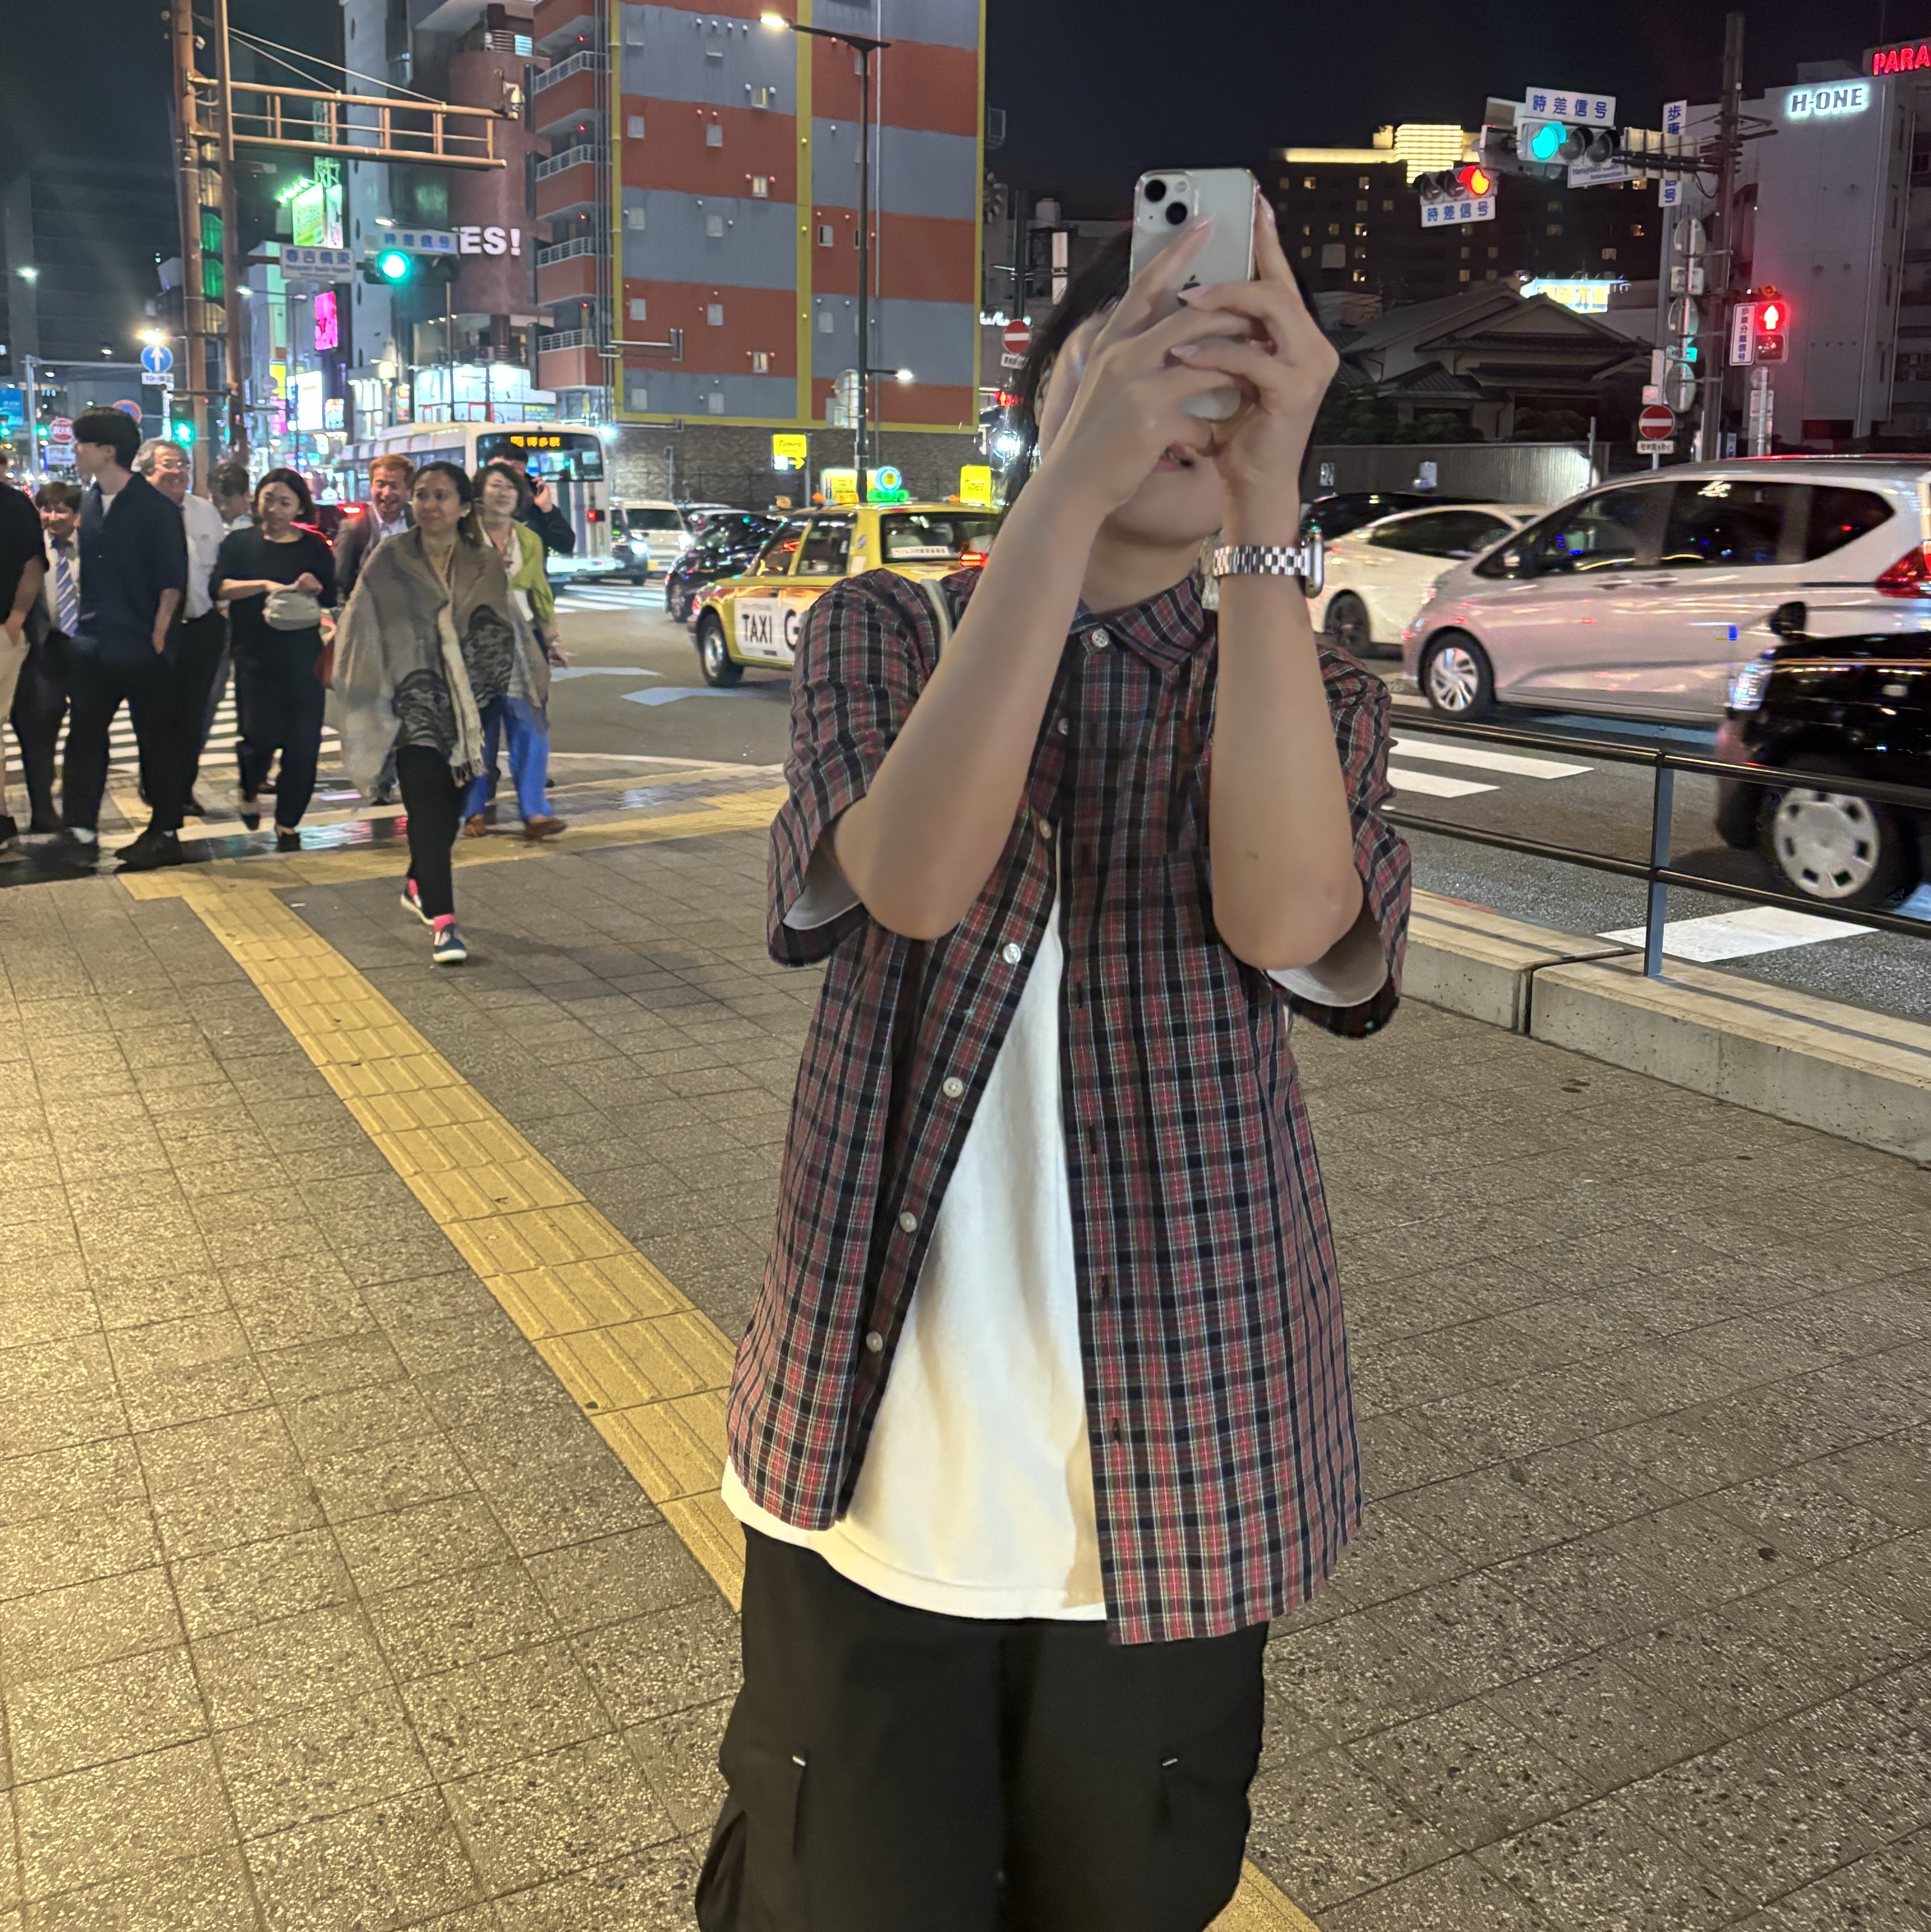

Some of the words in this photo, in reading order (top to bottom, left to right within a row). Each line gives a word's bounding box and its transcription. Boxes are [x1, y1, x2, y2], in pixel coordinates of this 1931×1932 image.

[1533, 95, 1607, 119] 時差信号
[1427, 201, 1489, 221] 時差信号
[452, 226, 520, 256] ES!
[742, 614, 772, 643] TAXI
